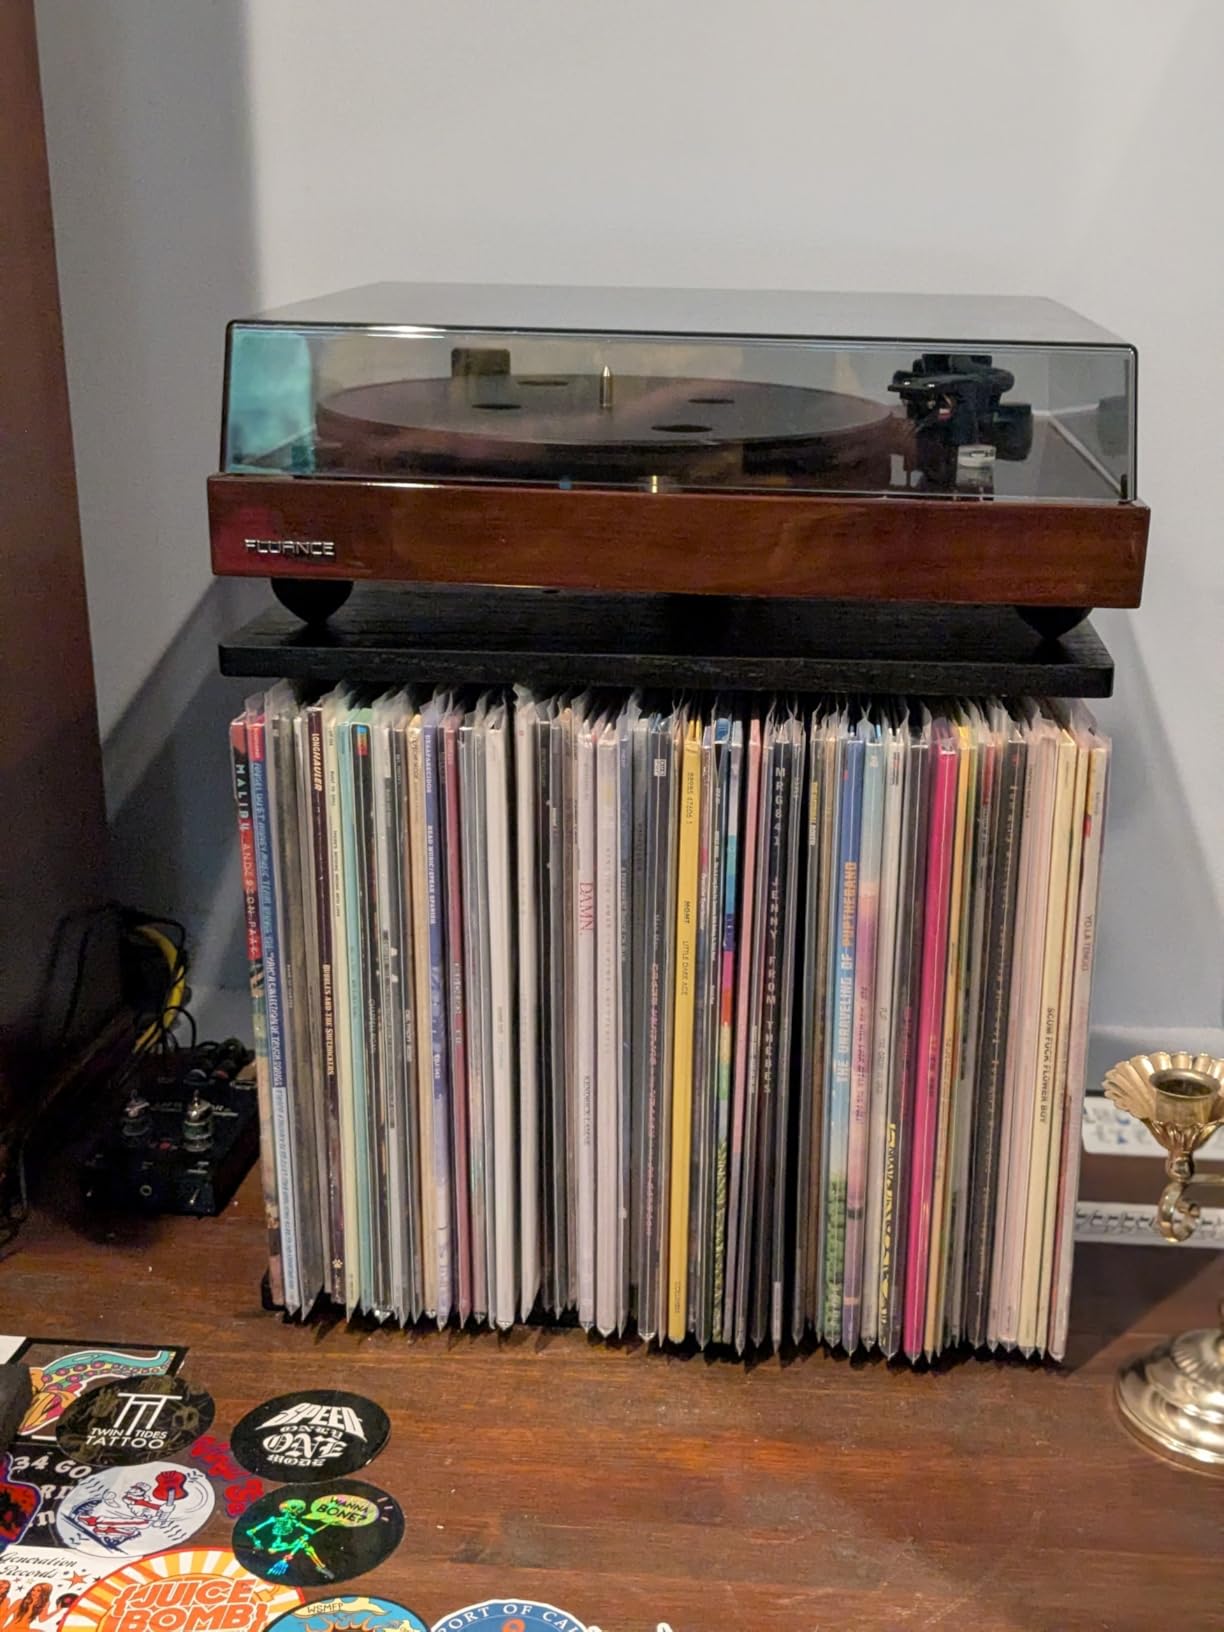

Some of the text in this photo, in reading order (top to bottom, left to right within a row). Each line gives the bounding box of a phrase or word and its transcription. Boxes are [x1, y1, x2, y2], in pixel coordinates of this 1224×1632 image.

[245, 539, 335, 556] FLUANCE
[312, 732, 322, 791] LONGHAULER
[236, 764, 249, 831] MALIBU
[579, 882, 594, 936] DAMN.
[682, 940, 690, 960] LITTLE
[1080, 916, 1092, 972] YO LA TENGO
[836, 861, 857, 1083] THE UNRAVELING OF PUPTHEBAND
[764, 876, 778, 1094] JENNY FROM THEBES
[1040, 1007, 1055, 1124] SCUM FUCK FLOWER BOY
[255, 1402, 368, 1443] SPEED
[280, 1424, 344, 1440] ONLY
[84, 1435, 164, 1450] TATTOO
[90, 1427, 168, 1440] TWIN TIDES
[262, 1432, 348, 1458] ONE
[266, 1454, 327, 1467] MODE
[316, 1504, 368, 1523] BONE?
[330, 1496, 369, 1513] WANNA
[0, 1551, 78, 1568] Generation
[0, 1564, 58, 1579] Records
[127, 1578, 257, 1609] JUICE
[306, 1602, 344, 1614] WSMFP
[503, 1604, 532, 1616] OF
